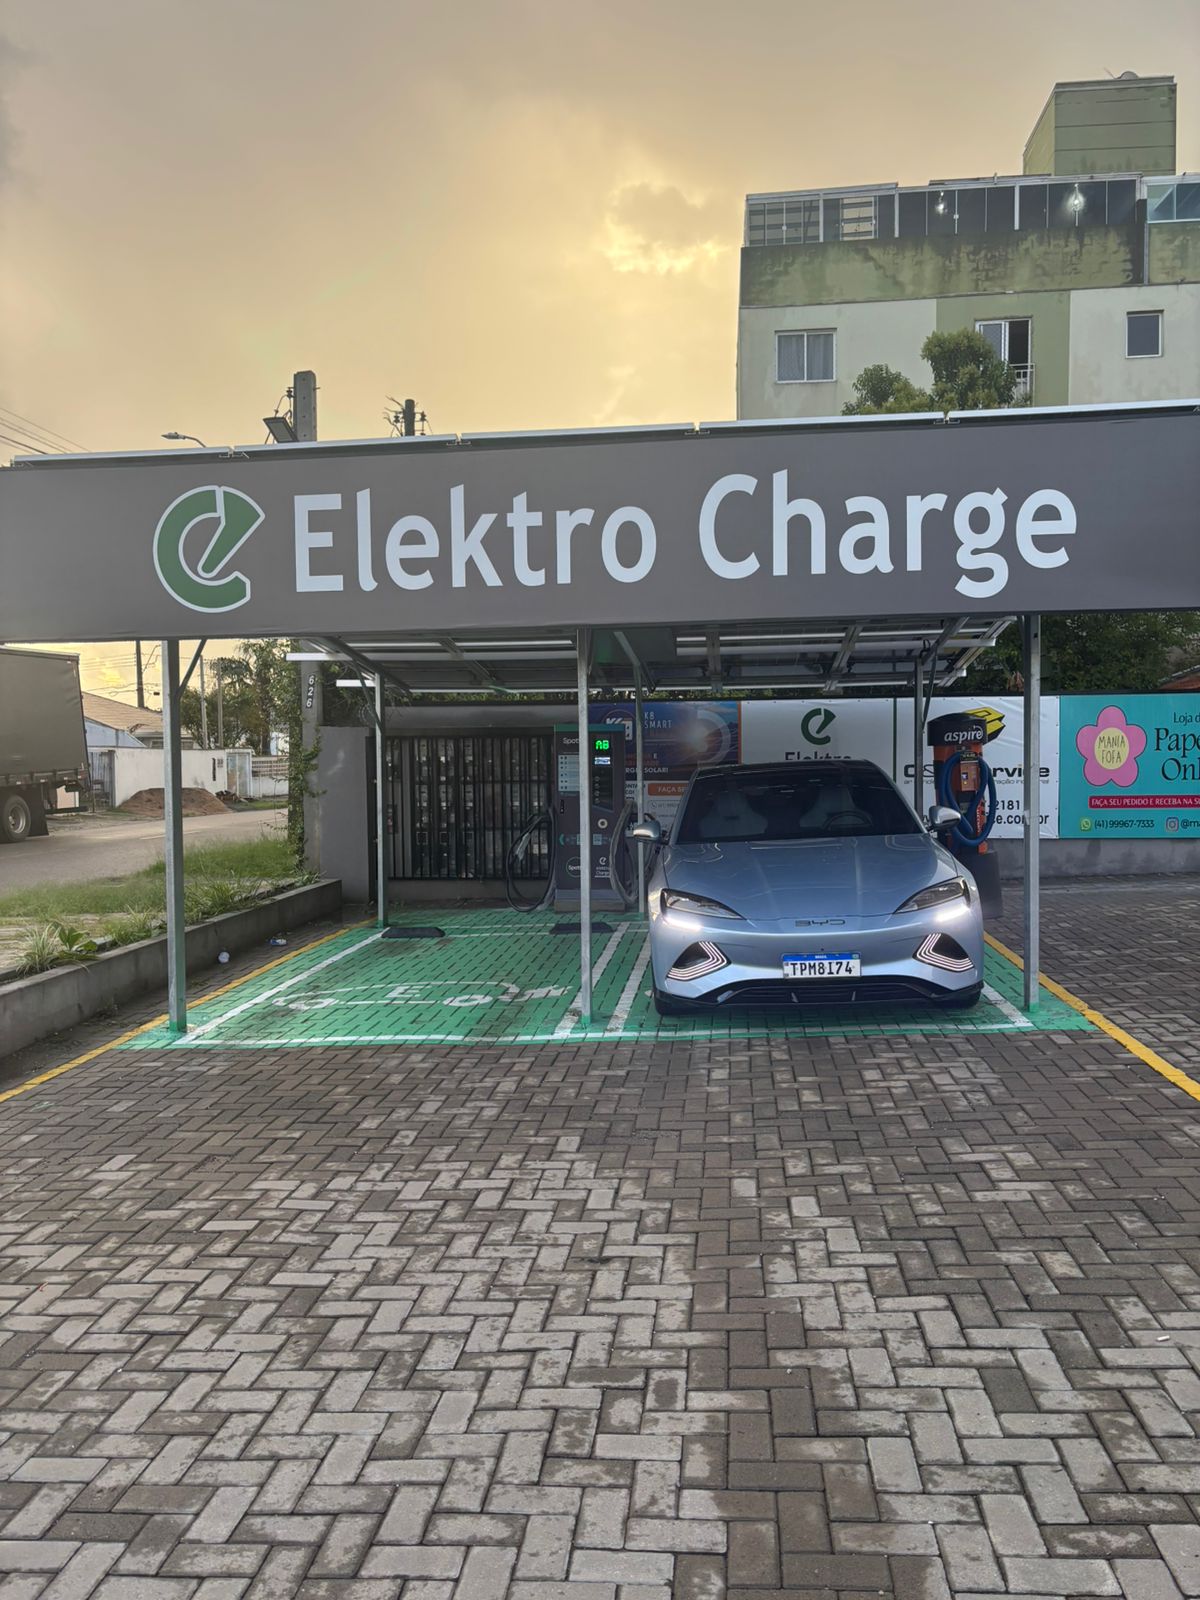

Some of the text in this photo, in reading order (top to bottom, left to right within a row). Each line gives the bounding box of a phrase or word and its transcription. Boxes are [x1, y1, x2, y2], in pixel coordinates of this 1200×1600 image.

[294, 484, 657, 593] Elektro
[699, 468, 1077, 598] Charge
[306, 675, 315, 708] 626
[644, 720, 672, 729] SMART
[1173, 712, 1192, 726] Loja
[944, 725, 984, 744] aspire
[1098, 735, 1126, 749] MANIA
[1102, 749, 1122, 764] FOFA
[1092, 798, 1108, 807] FAÇA
[1109, 798, 1122, 806] SEU
[1123, 797, 1149, 806] PEDIDO
[1150, 797, 1154, 806] E
[1155, 797, 1181, 806] RECEBA
[1183, 796, 1192, 805] NA
[795, 919, 846, 927] BYD
[790, 961, 853, 976] TPM8I74
